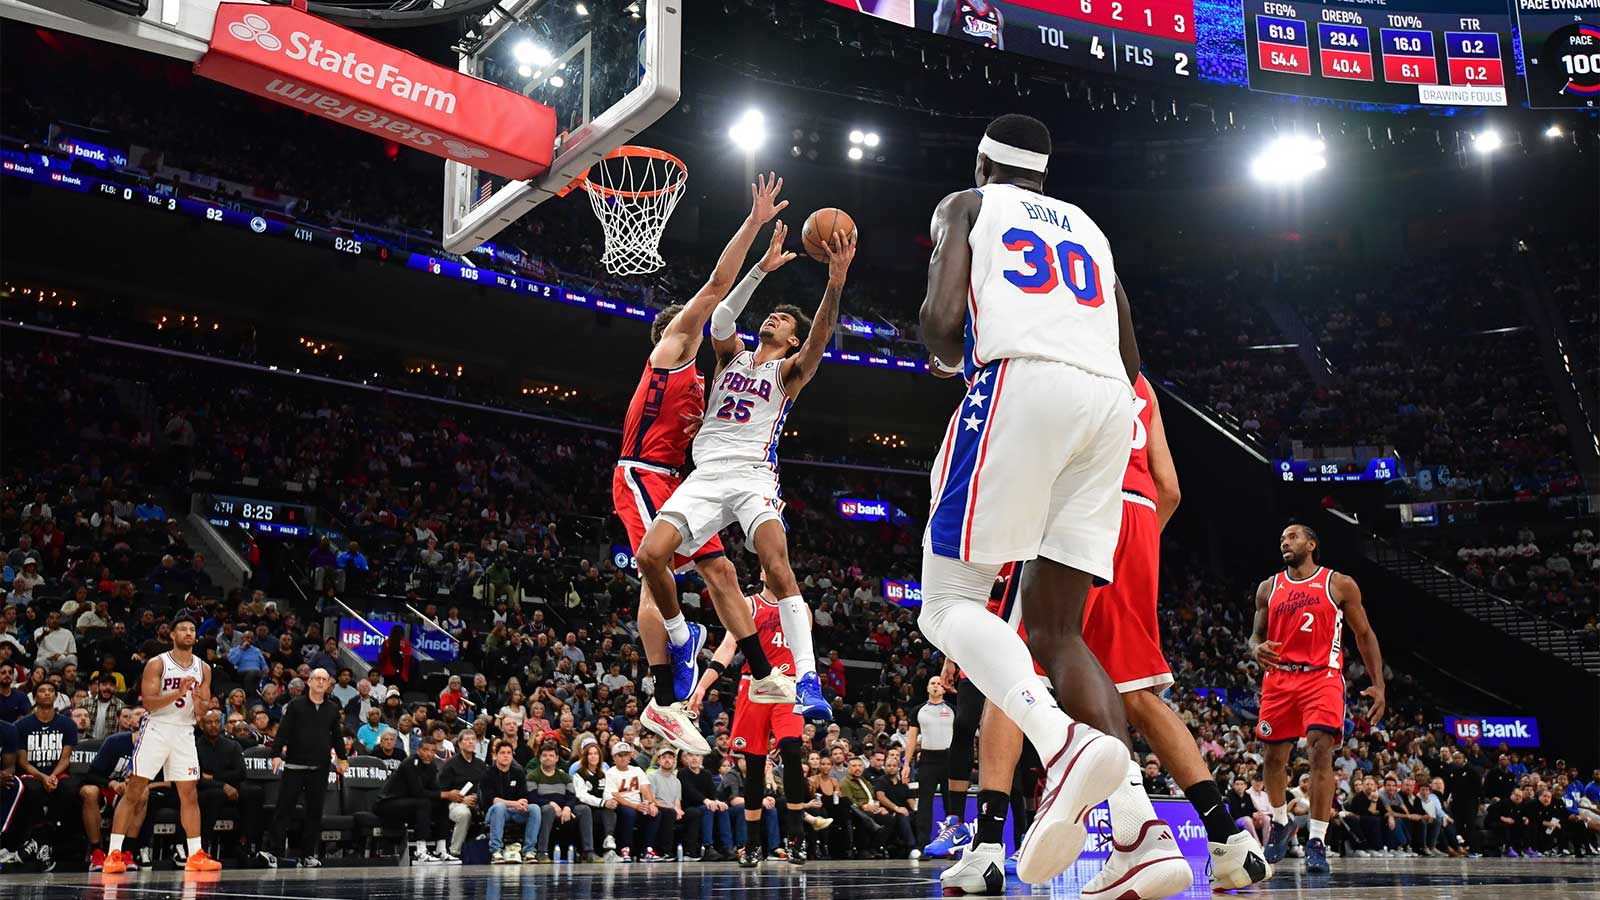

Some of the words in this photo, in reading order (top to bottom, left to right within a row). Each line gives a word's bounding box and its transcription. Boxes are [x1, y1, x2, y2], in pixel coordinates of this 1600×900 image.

[1520, 0, 1550, 10] PACE
[1112, 2, 1123, 20] 2
[1144, 9, 1152, 26] 1
[1174, 14, 1185, 32] 3
[1264, 2, 1296, 17] EFG%
[1322, 9, 1362, 24] OREB%
[1387, 14, 1422, 28] TOV%
[1460, 18, 1480, 30] FTR
[1038, 26, 1069, 49] TOL
[1090, 36, 1104, 60] 4
[1269, 25, 1295, 40] 61.9
[1330, 32, 1358, 47] 29.4
[1393, 37, 1421, 52] 16.0
[1462, 40, 1484, 53] 0.2
[1570, 36, 1592, 45] PACE
[1125, 44, 1153, 66] FLS
[1174, 52, 1190, 76] 2
[1271, 52, 1298, 67] 54.4
[1332, 58, 1361, 74] 40.4
[1402, 64, 1420, 78] 6.1
[1465, 66, 1487, 80] 0.2
[1424, 90, 1468, 102] DRAWING
[1471, 91, 1502, 102] FOULS
[75, 145, 105, 160] bank
[15, 164, 34, 174] bank
[62, 175, 81, 185] bank
[124, 188, 132, 200] 0
[168, 198, 176, 210] 3
[206, 208, 222, 221] 92
[1022, 201, 1072, 232] BONA
[294, 228, 312, 242] 4TH
[335, 237, 362, 254] 8:25
[460, 267, 479, 280] 105
[1002, 227, 1105, 308] 30
[510, 279, 517, 289] 4
[544, 287, 550, 296] 2
[574, 294, 586, 303] bank
[719, 372, 772, 402] PHILA
[716, 396, 755, 424] 25
[1282, 471, 1294, 481] 92
[1374, 468, 1390, 478] 105
[1320, 464, 1338, 474] 8:25
[763, 497, 778, 509] 76
[842, 503, 857, 513] us
[857, 503, 886, 516] bank
[214, 502, 233, 514] 4TH
[242, 503, 273, 520] 8:25
[293, 527, 298, 535] 2
[887, 585, 903, 597] us
[905, 584, 922, 600] ba
[1288, 589, 1305, 602] Los
[1276, 595, 1321, 617] Angeles
[1300, 612, 1315, 632] 2
[343, 632, 360, 645] us
[1457, 723, 1479, 737] us
[1482, 719, 1528, 738] bank
[27, 733, 63, 750] BLACK
[27, 749, 62, 762] HISTORY
[70, 751, 84, 763] GET
[85, 751, 98, 763] TH
[254, 758, 266, 770] THE
[188, 767, 198, 776] 76
[356, 767, 369, 778] THE
[618, 776, 639, 792] LA
[1177, 820, 1206, 842] xfini
